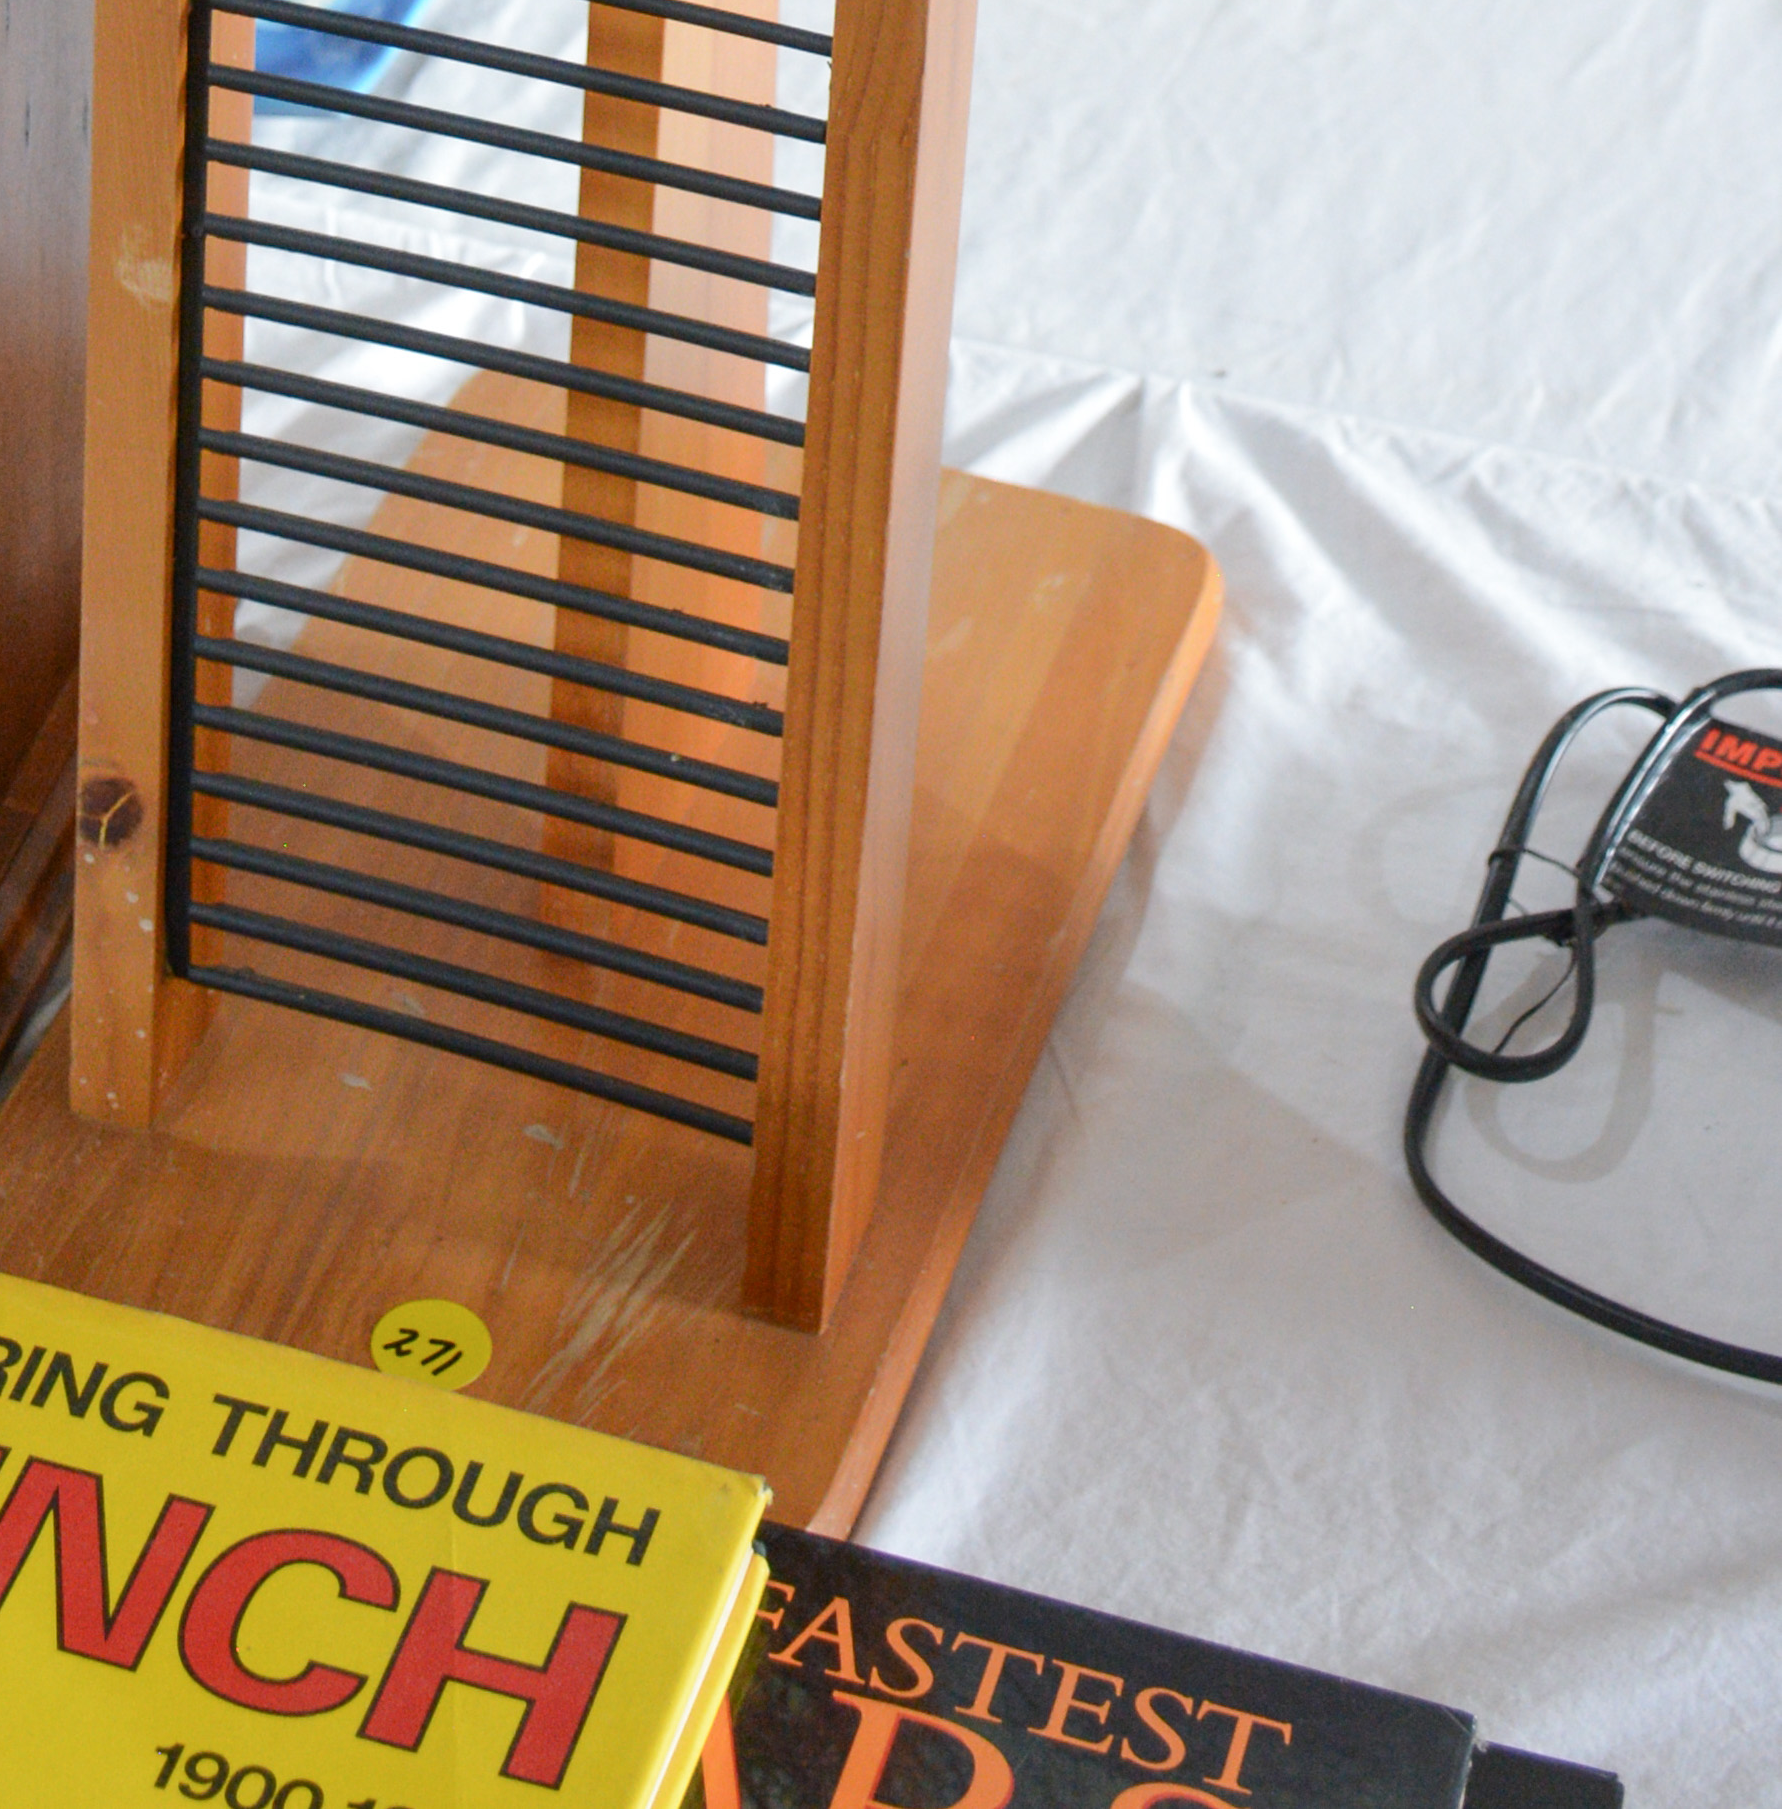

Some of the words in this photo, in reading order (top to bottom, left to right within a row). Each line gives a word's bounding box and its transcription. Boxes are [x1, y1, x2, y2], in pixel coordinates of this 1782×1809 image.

[1627, 829, 1694, 870] BEFORE
[1692, 861, 1781, 893] SWITCHING
[383, 1327, 464, 1377] 271
[211, 1393, 662, 1568] THROUGH
